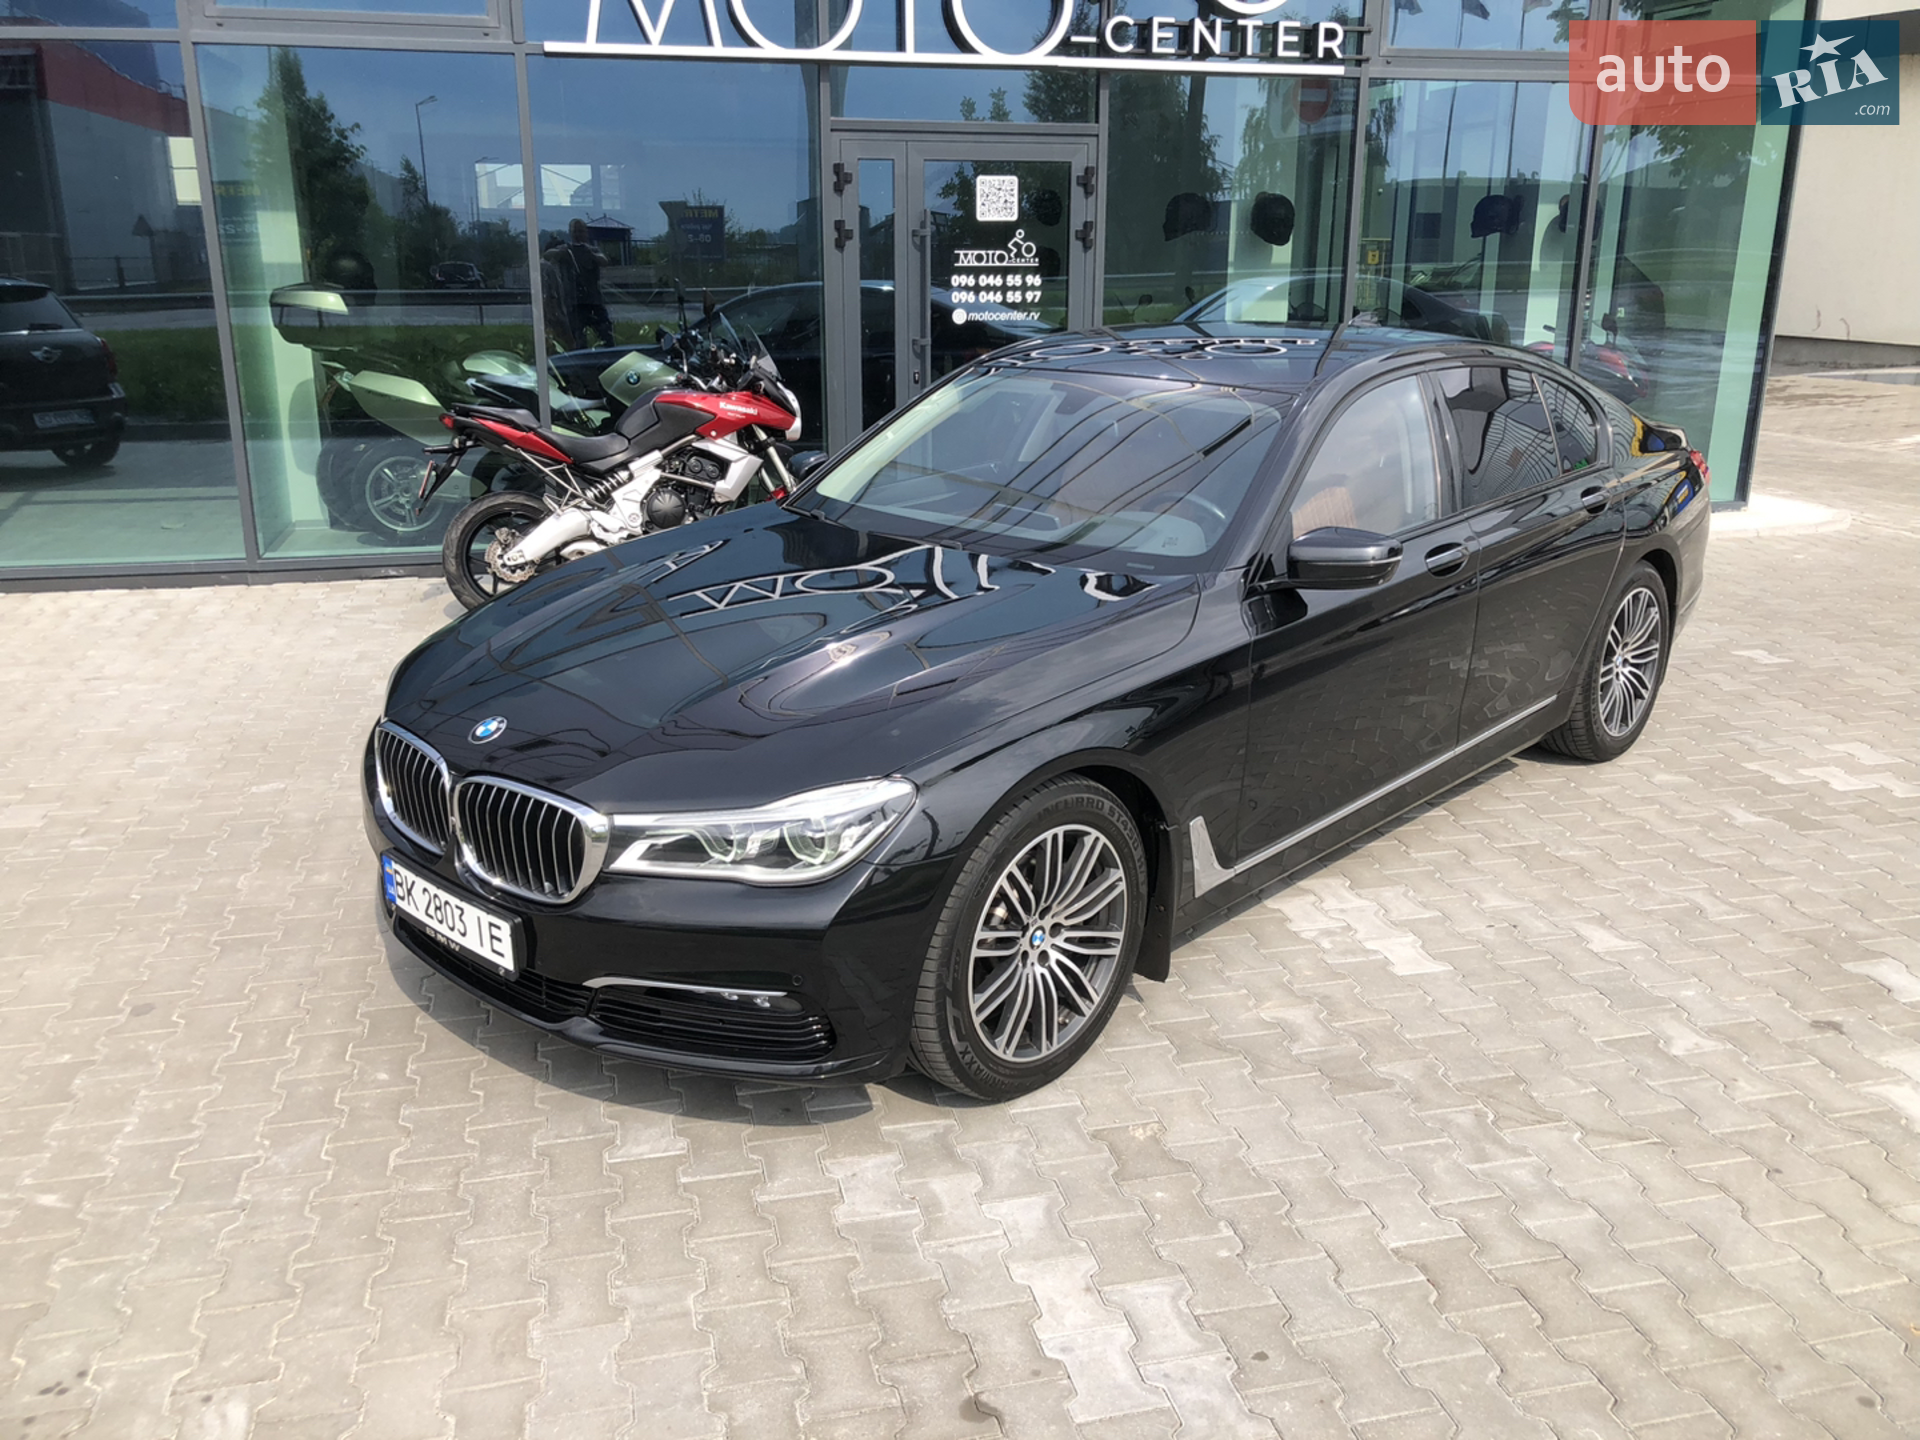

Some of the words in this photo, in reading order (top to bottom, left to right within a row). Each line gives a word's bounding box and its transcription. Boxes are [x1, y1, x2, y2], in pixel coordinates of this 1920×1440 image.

[954, 250, 1009, 266] MOTO
[951, 275, 975, 287] 096
[979, 275, 1003, 287] 046
[1006, 275, 1022, 287] 55
[1025, 275, 1041, 287] 96
[951, 291, 975, 303] 096
[979, 291, 1003, 303] 046
[1006, 291, 1022, 303] 55
[1025, 291, 1041, 303] 97
[719, 401, 758, 416] Kawasaki
[394, 868, 419, 912] BK
[421, 886, 468, 938] 2803
[477, 915, 505, 958] IE
[425, 926, 461, 952] BMW
